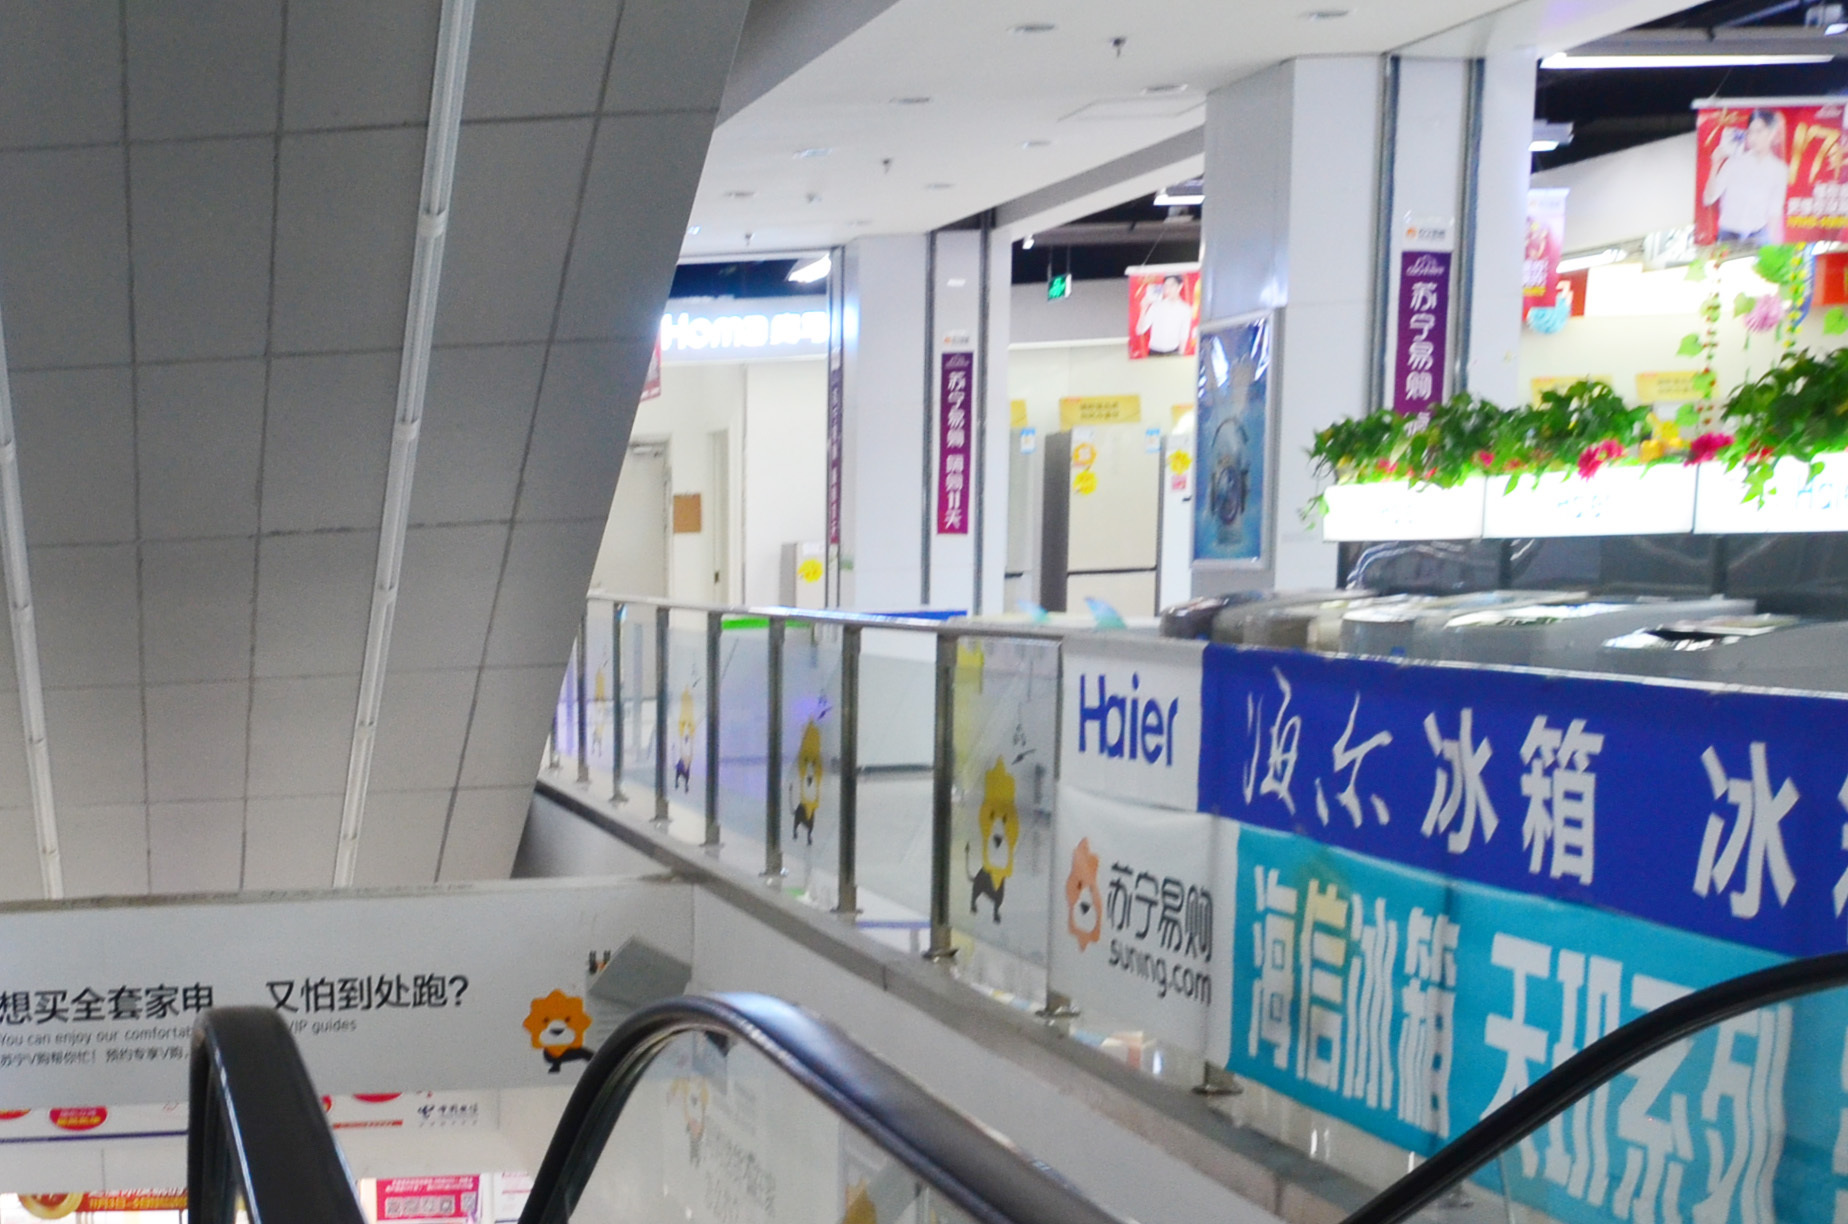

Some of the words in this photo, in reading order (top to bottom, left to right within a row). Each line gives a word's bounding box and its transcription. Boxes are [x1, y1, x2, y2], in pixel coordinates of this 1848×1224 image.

[1406, 281, 1438, 400] 苏宁易购
[1079, 673, 1179, 768] Haier
[1692, 740, 1848, 919] 冰
[1106, 860, 1214, 966] 苏宁易购
[265, 973, 470, 1015] 又怕到处跑?
[1109, 937, 1212, 1008] suning.com
[1248, 860, 1460, 1140] 海信冰箱
[0, 1032, 24, 1047] You
[27, 1033, 50, 1046] can
[54, 1029, 92, 1046] enjoy
[96, 1030, 118, 1042] our
[311, 1018, 358, 1035] guides
